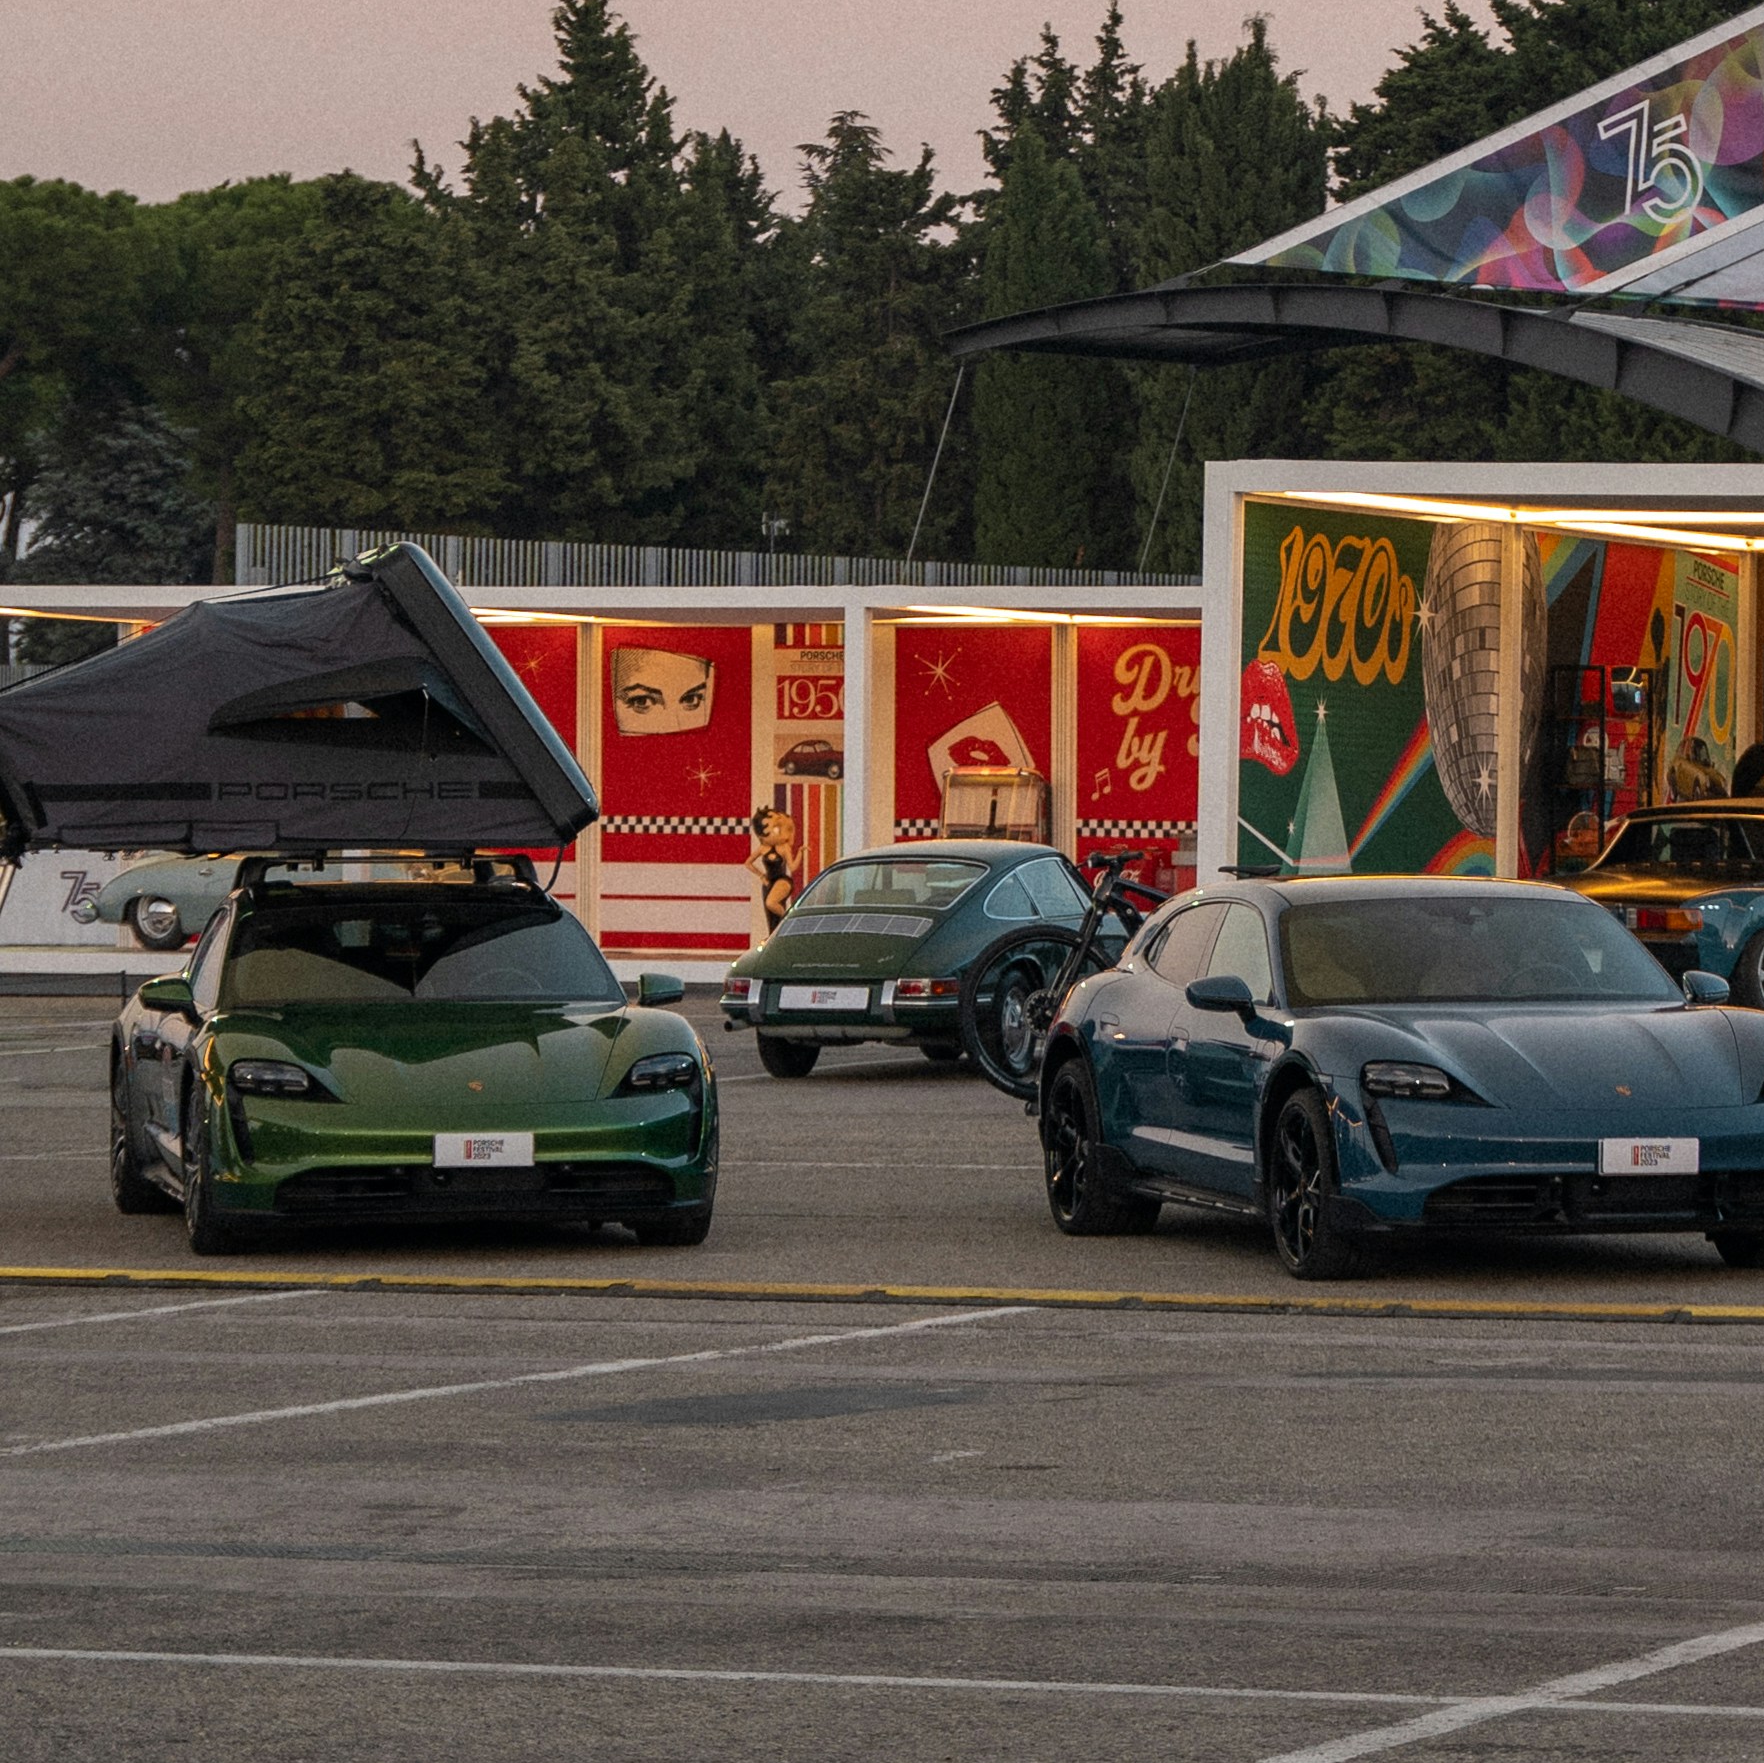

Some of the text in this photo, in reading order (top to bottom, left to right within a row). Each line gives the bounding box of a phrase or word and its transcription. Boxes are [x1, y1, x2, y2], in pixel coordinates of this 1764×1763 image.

[1597, 99, 1703, 224] 75
[1693, 559, 1725, 591] PORSCHE
[1257, 525, 1415, 686] 1970s
[799, 650, 845, 661] PORSCHE
[1674, 601, 1736, 760] 1970
[1116, 716, 1168, 791] by
[216, 780, 476, 801] PORSCHE
[60, 870, 101, 924] 75
[472, 1139, 504, 1147] PORSCHE
